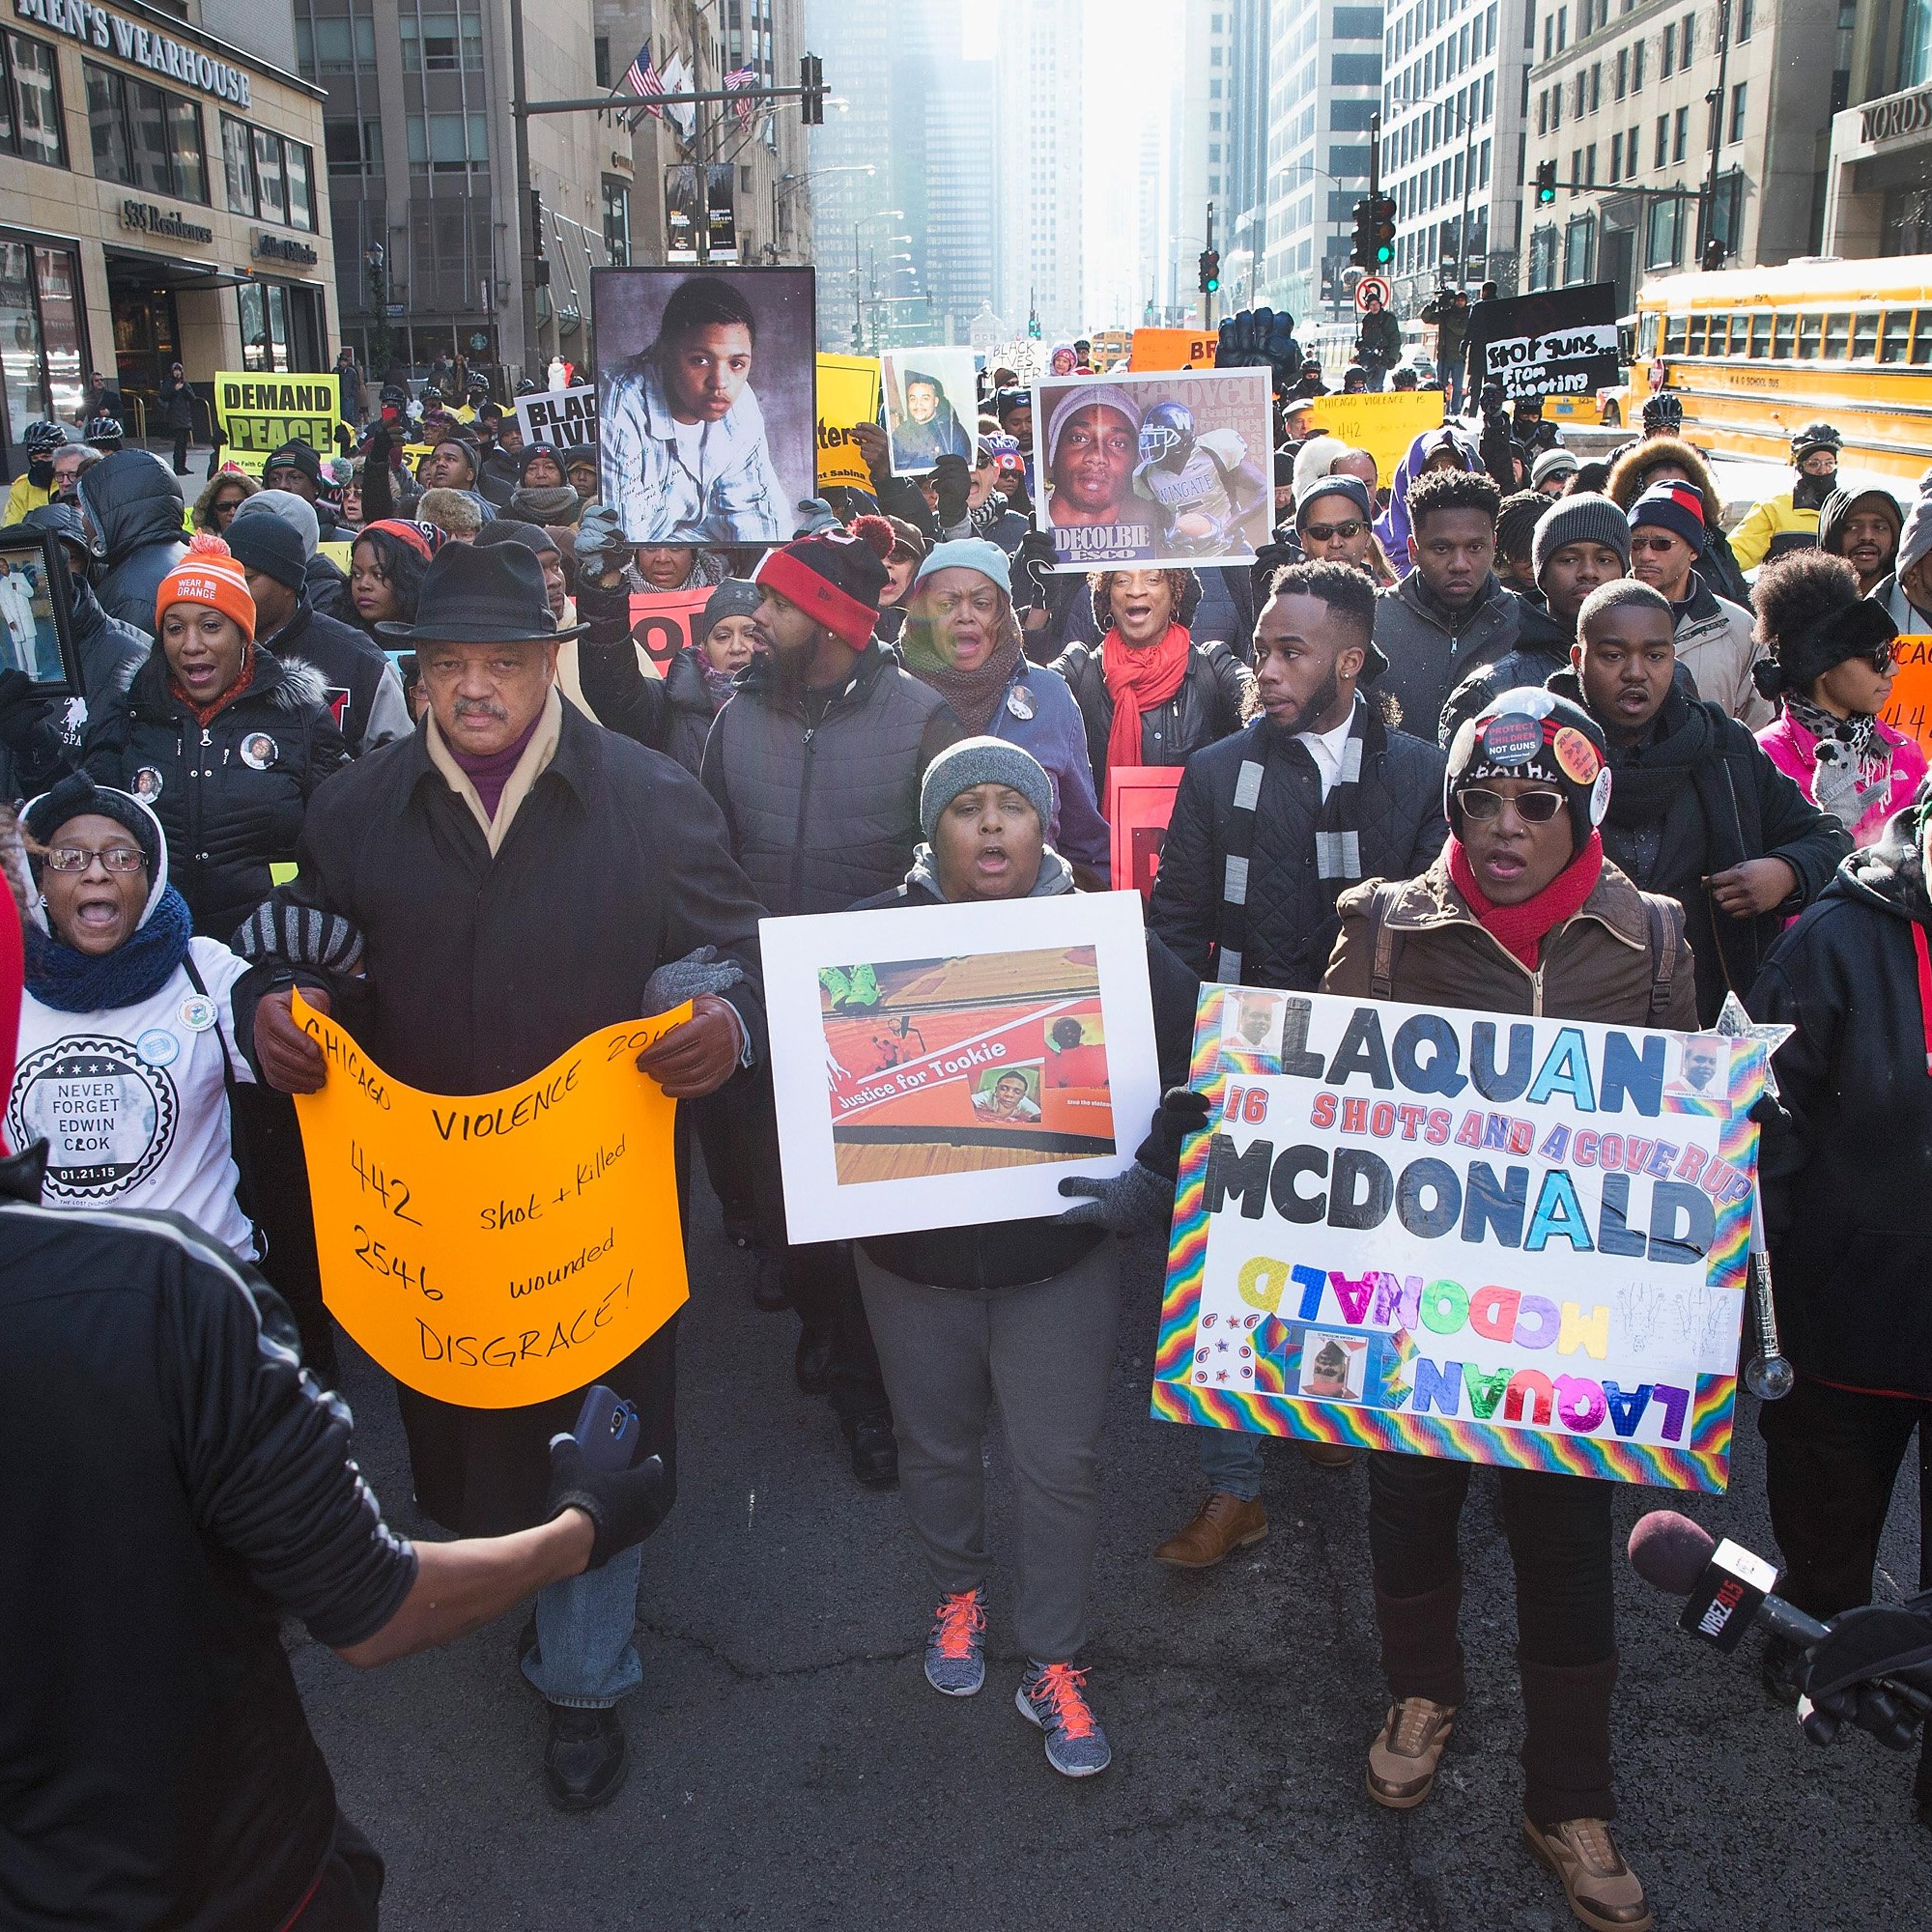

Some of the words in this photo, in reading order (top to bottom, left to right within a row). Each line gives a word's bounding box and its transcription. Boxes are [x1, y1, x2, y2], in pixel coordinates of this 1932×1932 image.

[18, 0, 109, 48] MEN'S
[109, 15, 250, 108] WEARHOUSE
[149, 206, 212, 244] Residences
[993, 342, 1035, 357] BLACK
[989, 355, 1033, 368] LIVES
[982, 367, 1041, 386] MTER
[1746, 377, 1766, 387] SCHOOL
[224, 383, 332, 411] DEMAND
[1123, 377, 1265, 409] Beloved
[1318, 397, 1357, 410] CHICAGO
[1364, 395, 1404, 406] VIOLENCE
[229, 418, 330, 451] PEACE
[1338, 422, 1362, 439] 442
[830, 469, 865, 480] Sabina
[1157, 474, 1216, 503] WINGATE
[1054, 525, 1151, 551] DECOLBIE
[1070, 549, 1136, 561] ESCO
[178, 579, 201, 587] WEAR
[177, 587, 216, 600] ORANGE
[1488, 721, 1535, 735] PROTECT
[60, 733, 82, 746] SPA
[1489, 732, 1536, 746] CHILDREN
[1489, 745, 1508, 755] NOT
[1509, 742, 1536, 752] GUNS
[1283, 997, 1667, 1116] LAQUAN
[304, 1017, 391, 1110] CHICAGO
[432, 1059, 582, 1141] VIOLENCE
[838, 1081, 896, 1110] Justice
[896, 1064, 928, 1091] for
[929, 1041, 1007, 1082] Tookie
[58, 1083, 114, 1097] NEVER
[53, 1099, 120, 1113] FORGET
[59, 1118, 115, 1132] EDWIN
[1223, 1085, 1269, 1125] 16
[1310, 1093, 1453, 1146] SHOTS
[1454, 1109, 1536, 1156] AND
[61, 1168, 115, 1180] 01.21.15
[350, 1140, 423, 1227] 442
[1201, 1133, 1716, 1265] MCDONALD
[354, 1224, 444, 1302] 2546
[510, 1227, 615, 1299] wounded
[1237, 1256, 1610, 1360] MCDONALD
[1412, 1357, 1691, 1442] LAQUAN
[1698, 1598, 1733, 1637] WBEZ
